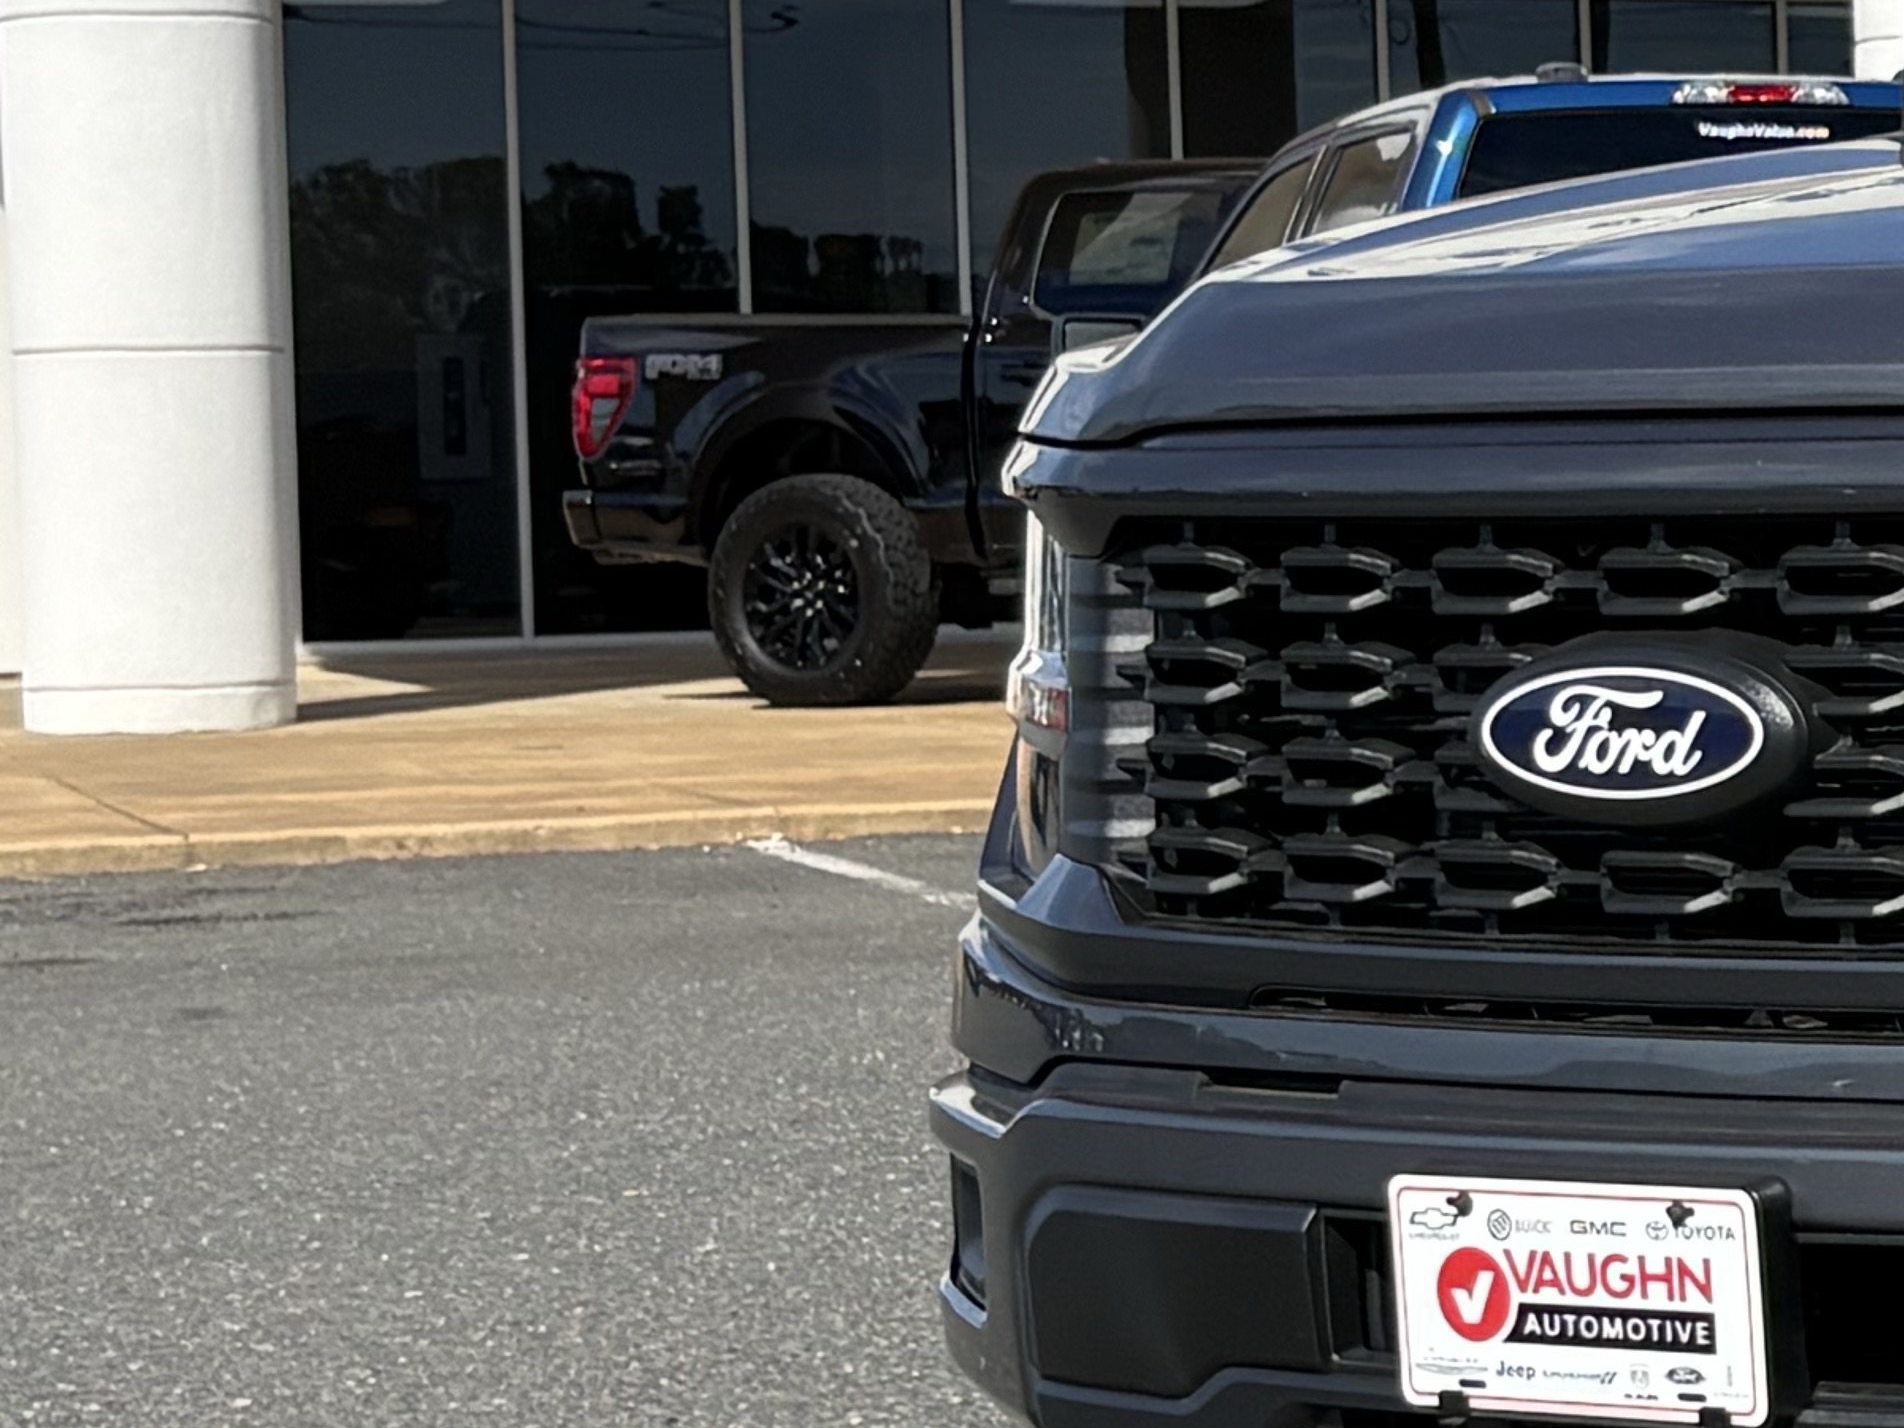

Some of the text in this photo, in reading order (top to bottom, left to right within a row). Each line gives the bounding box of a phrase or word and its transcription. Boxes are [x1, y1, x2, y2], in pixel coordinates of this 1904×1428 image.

[1533, 684, 1706, 777] Ford
[1515, 1220, 1553, 1234] BUICK
[1570, 1220, 1628, 1237] GMC
[1674, 1224, 1736, 1241] TOYOTA
[1502, 1247, 1713, 1304] VAUGHN
[1523, 1313, 1711, 1346] AUTOMOTIVE
[1496, 1360, 1536, 1380] Jeep
